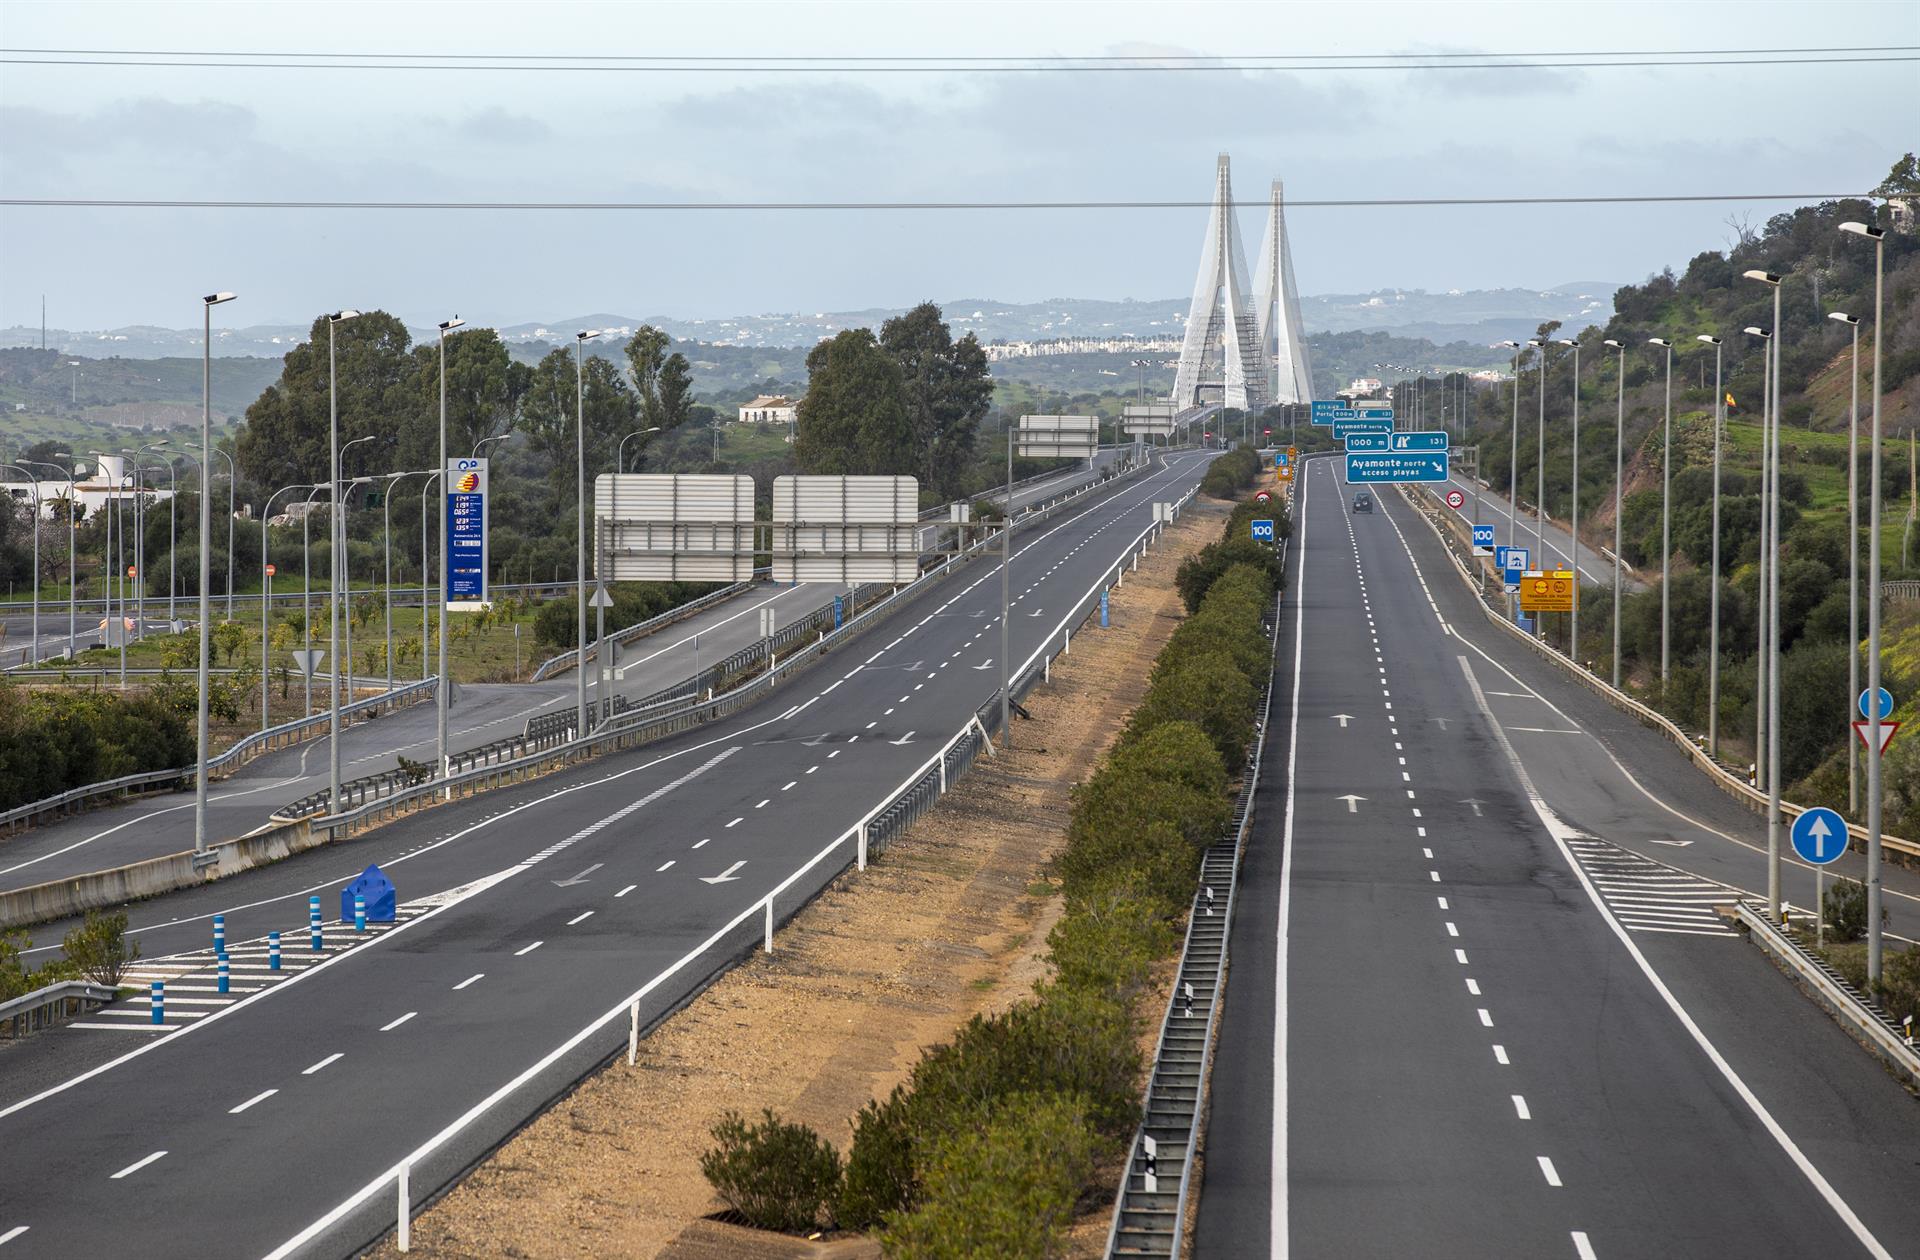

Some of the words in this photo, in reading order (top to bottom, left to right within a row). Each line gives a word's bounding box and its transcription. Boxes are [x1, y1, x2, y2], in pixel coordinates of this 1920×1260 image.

[1351, 459, 1401, 468] Ayamonte
[1393, 469, 1419, 477] playas
[1253, 526, 1272, 535] 100
[1474, 530, 1492, 540] 100
